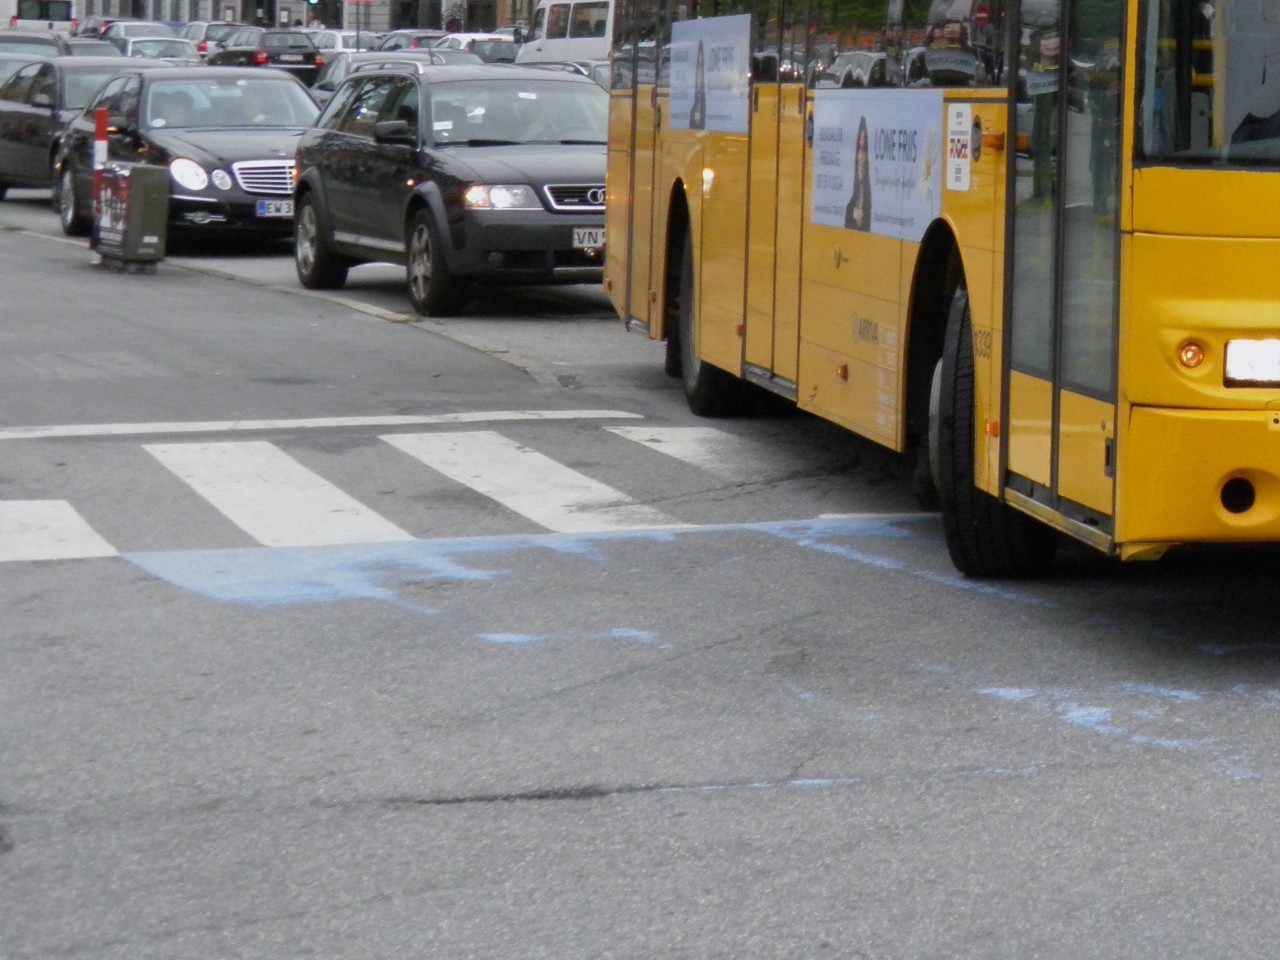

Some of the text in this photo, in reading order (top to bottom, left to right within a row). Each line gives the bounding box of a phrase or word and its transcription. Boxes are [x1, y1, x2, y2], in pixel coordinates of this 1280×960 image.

[874, 128, 897, 162] LONE
[898, 129, 917, 164] FRIIS
[576, 231, 598, 244] VN
